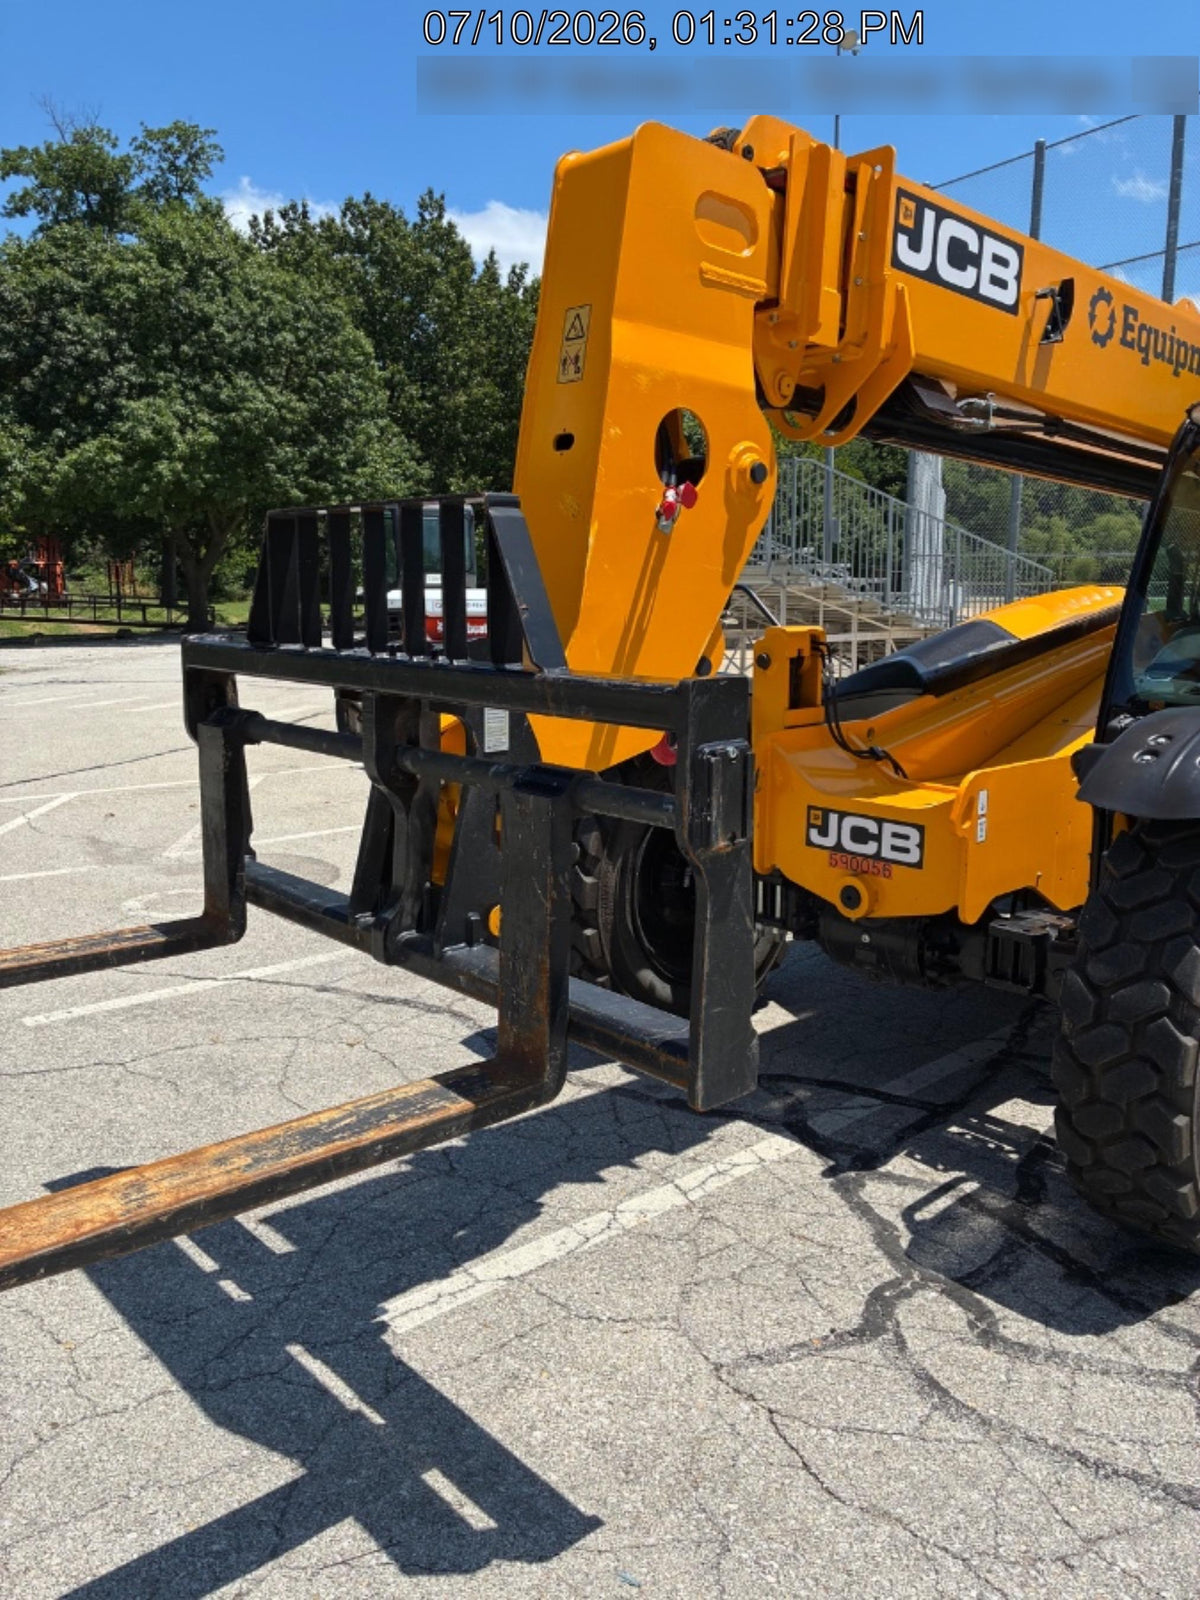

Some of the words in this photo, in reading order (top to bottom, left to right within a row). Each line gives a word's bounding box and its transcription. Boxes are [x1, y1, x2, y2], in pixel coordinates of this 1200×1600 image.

[896, 207, 1020, 307] JCB
[809, 812, 921, 864] JCB
[829, 853, 893, 879] 590056
